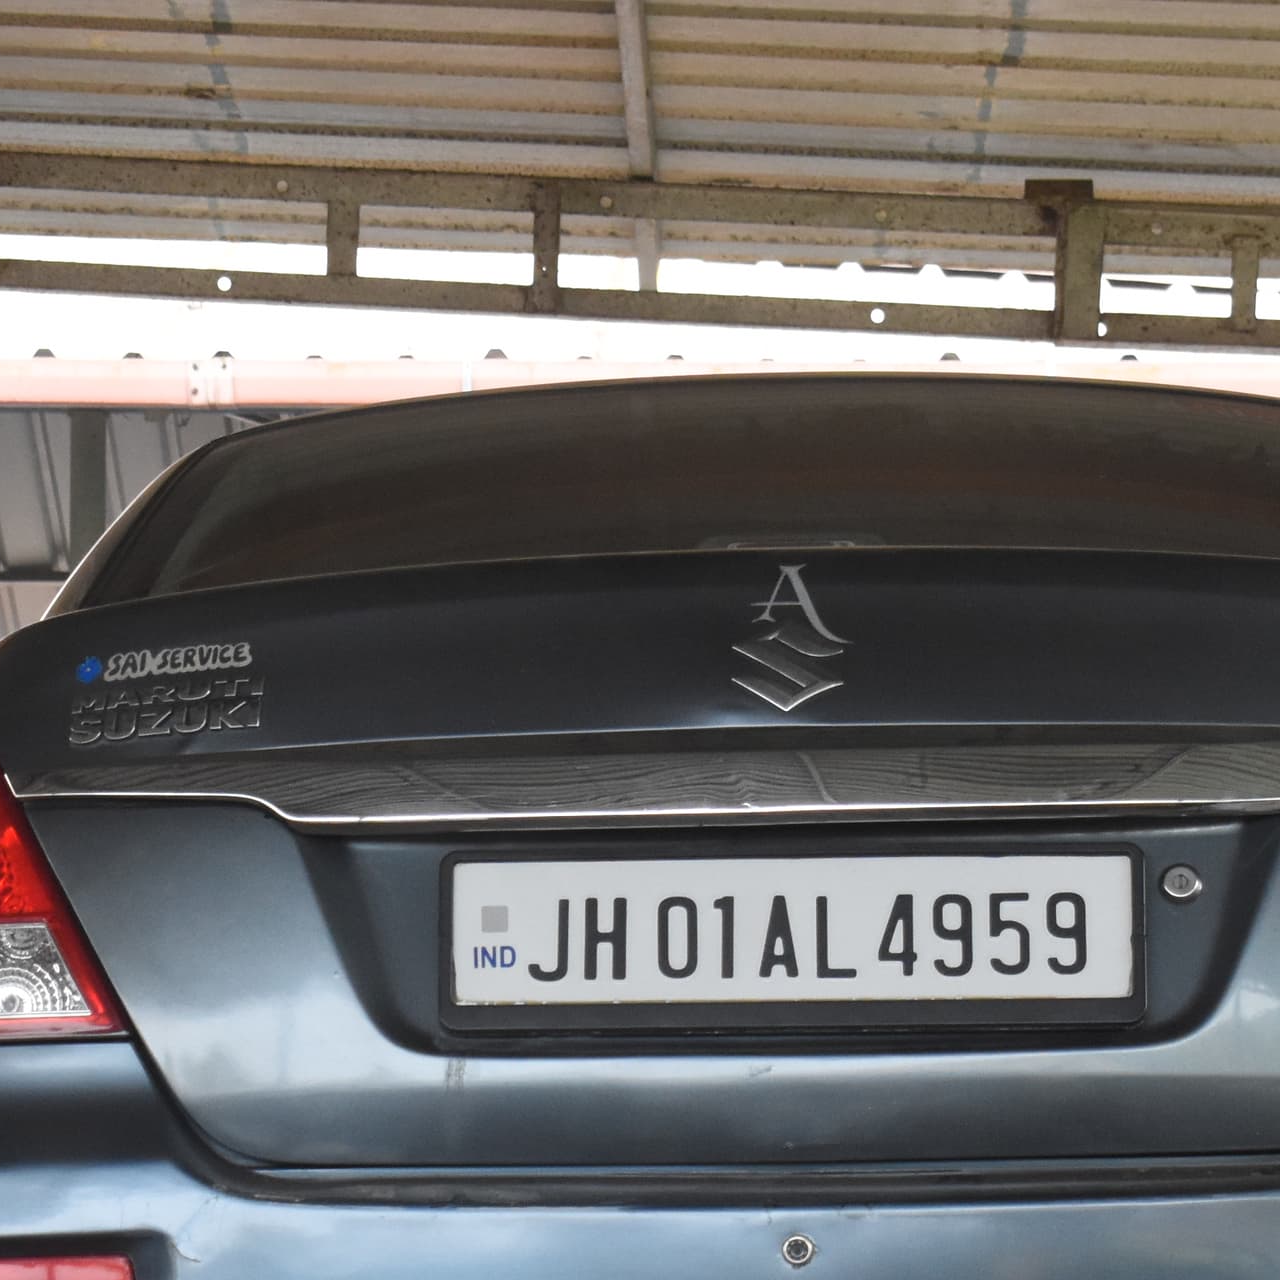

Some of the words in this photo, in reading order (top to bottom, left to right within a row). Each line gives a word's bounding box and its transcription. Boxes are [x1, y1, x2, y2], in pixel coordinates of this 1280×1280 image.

[106, 650, 149, 678] SAI
[156, 643, 249, 672] SERVICE
[71, 677, 264, 714] MARUTI
[69, 697, 261, 744] SUZUKI
[877, 891, 1088, 978] 4959
[473, 945, 517, 969] IND
